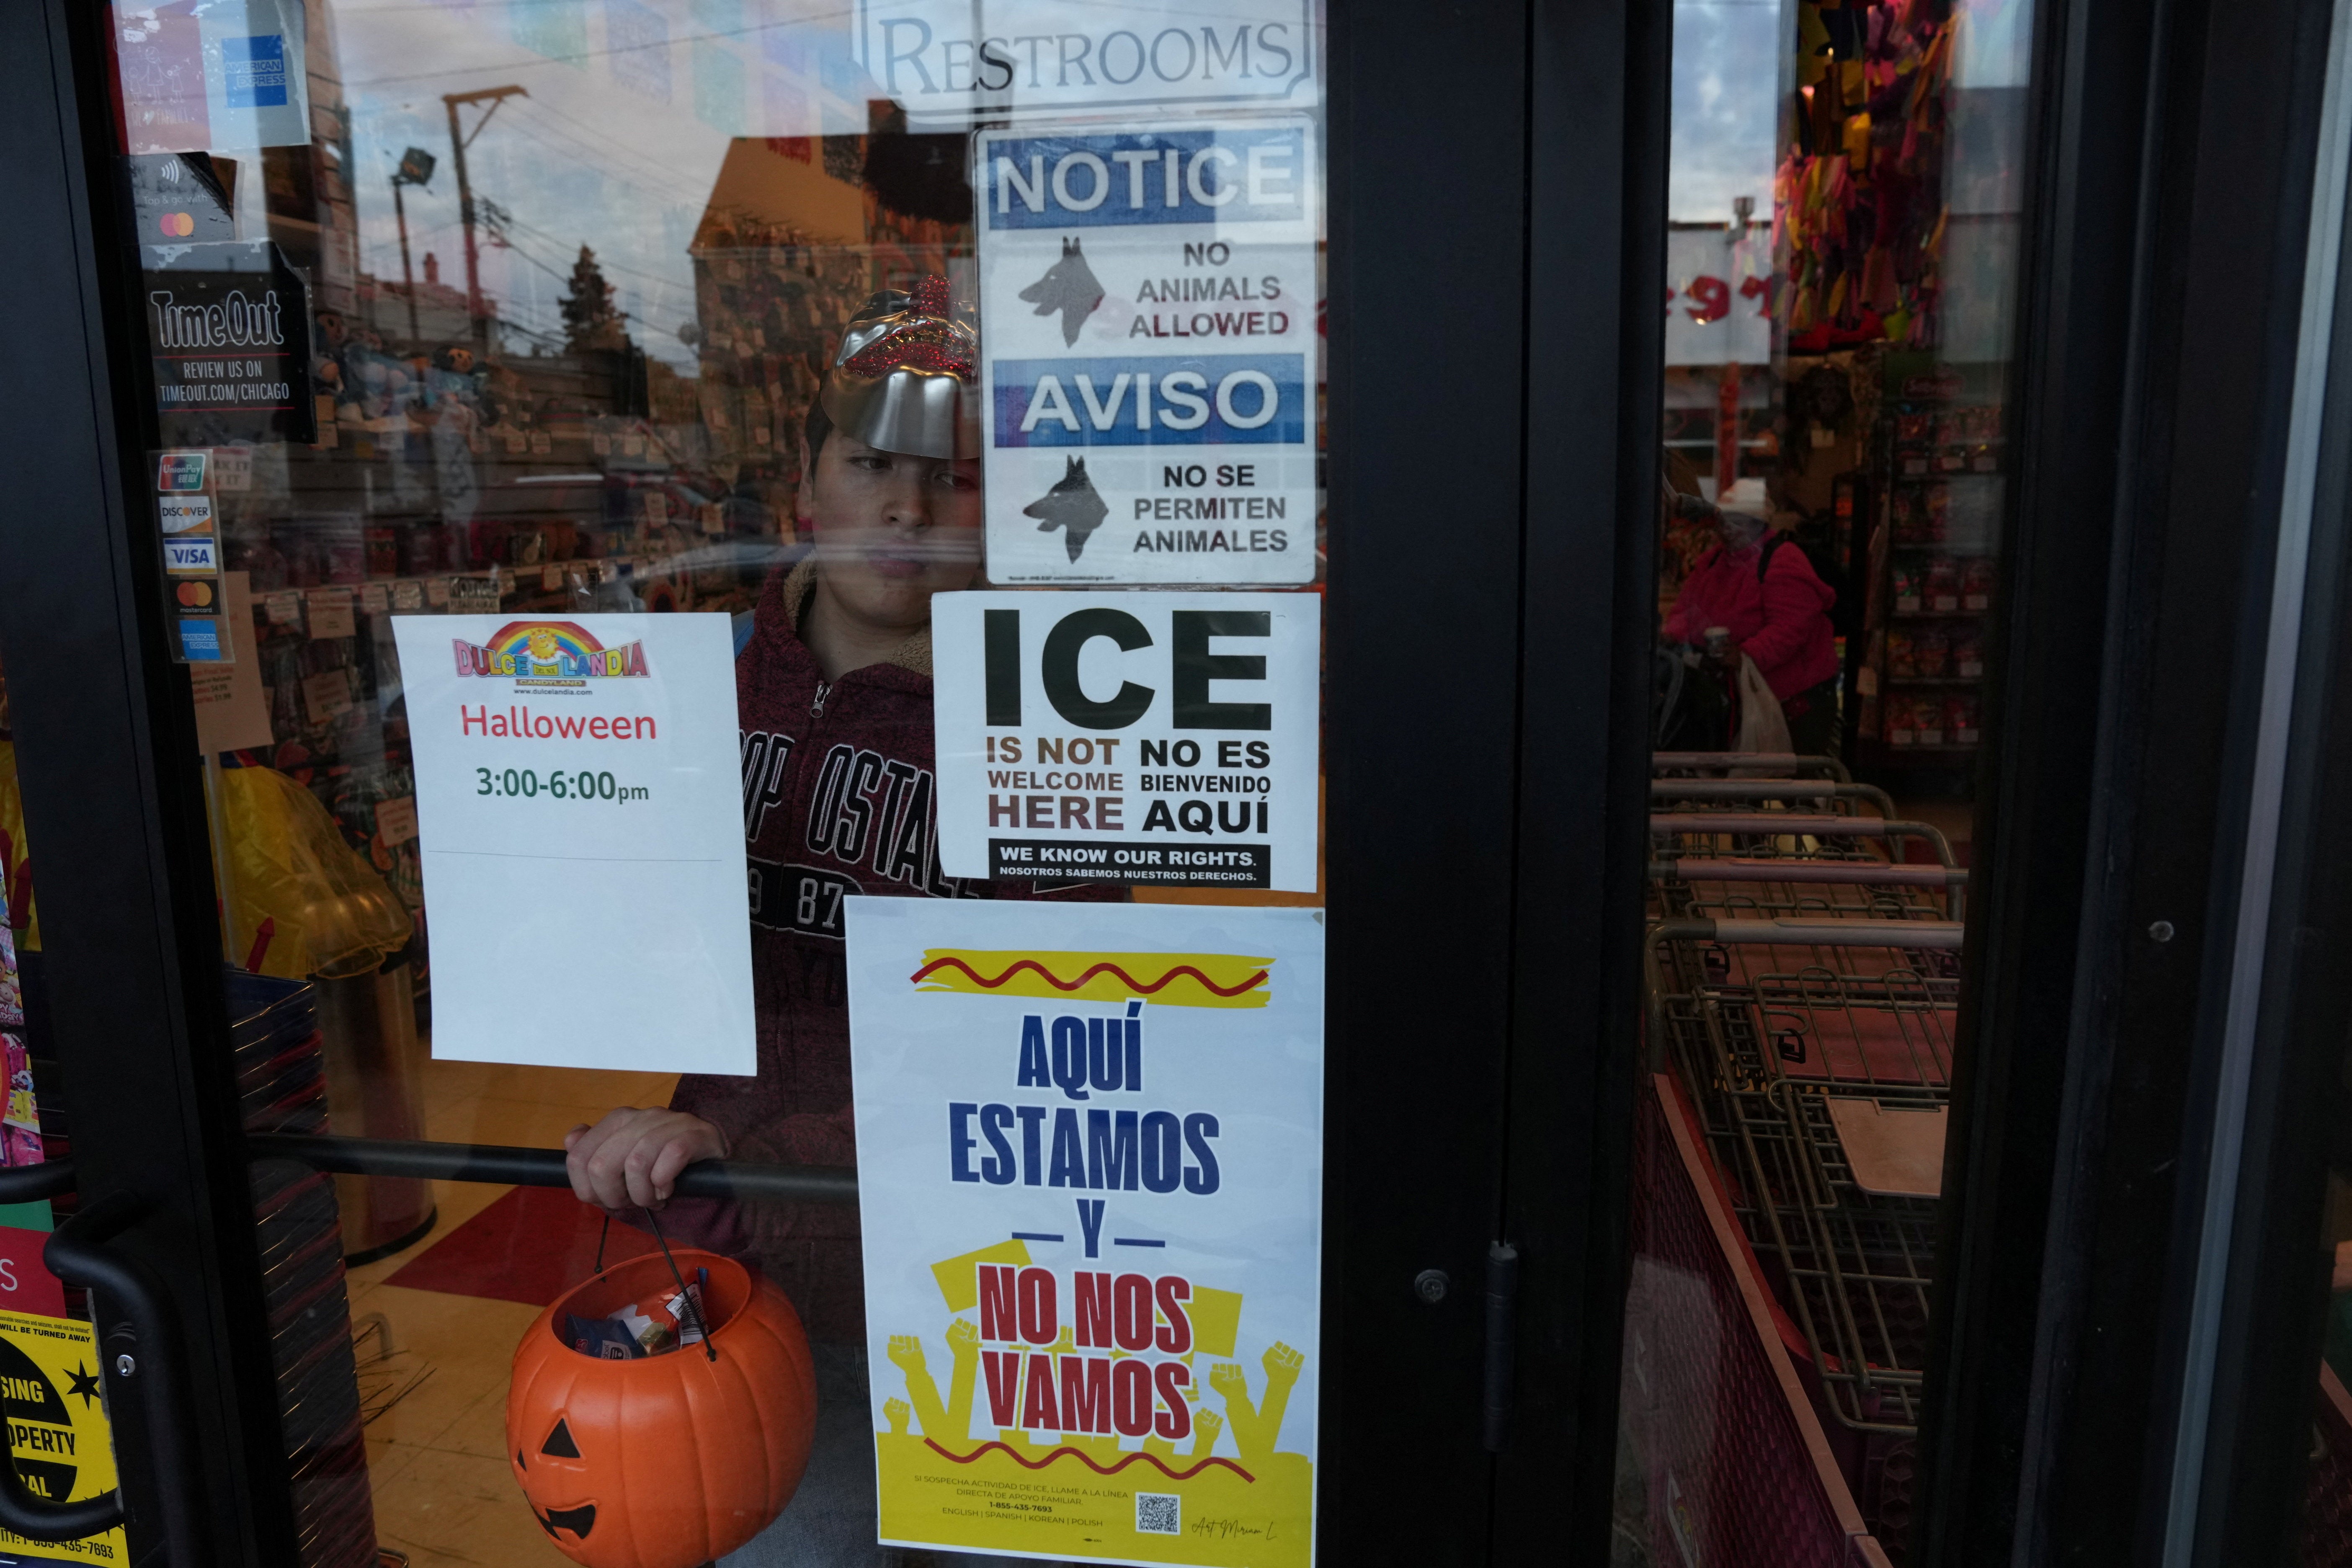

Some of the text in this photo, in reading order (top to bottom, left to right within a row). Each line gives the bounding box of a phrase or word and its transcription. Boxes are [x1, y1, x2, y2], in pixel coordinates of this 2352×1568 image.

[225, 61, 280, 74] AMERICAN
[879, 18, 1293, 96] RESTROOMS
[238, 75, 286, 86] EXPRESS
[997, 145, 1295, 214] NOTICE
[171, 196, 183, 206] go
[1183, 241, 1230, 266] NO
[1135, 276, 1282, 303] ANIMALS
[1129, 311, 1289, 338] ALLOWED
[183, 360, 263, 379] REVIEW US ON
[160, 382, 289, 404] TIMEOUT.COM/CHICAGO
[1019, 369, 1279, 432] AVISO
[163, 464, 201, 477] UnionPay
[1164, 465, 1255, 488] NO SE
[162, 507, 209, 516] DISCOVER
[1134, 497, 1286, 520] PERMITEN
[1133, 529, 1288, 553] ANIMALES
[171, 549, 209, 563] VISA
[452, 638, 650, 678] DULCE LANDIA
[984, 608, 1271, 730] ICE
[461, 704, 657, 740] Halloween
[987, 736, 1120, 765] IS NOT
[1140, 739, 1271, 769] NO ES
[987, 771, 1124, 792] WELCOME
[1140, 774, 1271, 794] BIENVENIDO
[988, 794, 1124, 831] HERE
[1142, 797, 1269, 836] AQUÍ
[1000, 847, 1257, 867] WE KNOW OUR RIGHTS.
[999, 867, 1257, 882] NOSOTROS SABEMOS NUESTROS DERECHOS.
[797, 877, 844, 930] 87
[1017, 1001, 1142, 1100] AQUÍ
[949, 1102, 1220, 1195] ESTAMOS
[977, 1265, 1190, 1354] NO NOS
[0, 1323, 18, 1332] WILL
[33, 1328, 66, 1339] TURNED
[68, 1334, 90, 1343] AWAY
[982, 1350, 1190, 1439] VAMOS
[924, 1475, 970, 1485] SOSPECHA
[971, 1480, 1017, 1490] ACTIVIDAD
[1103, 1489, 1128, 1498] LÍNEA
[957, 1488, 993, 1498] DIRECTA
[1009, 1493, 1039, 1502] APOYO
[1042, 1496, 1083, 1505] FAMILIAR.
[943, 1507, 1103, 1527] ENGLISH SPANISH KOREAN POLISH
[989, 1501, 1052, 1512] 1-855-435-7693
